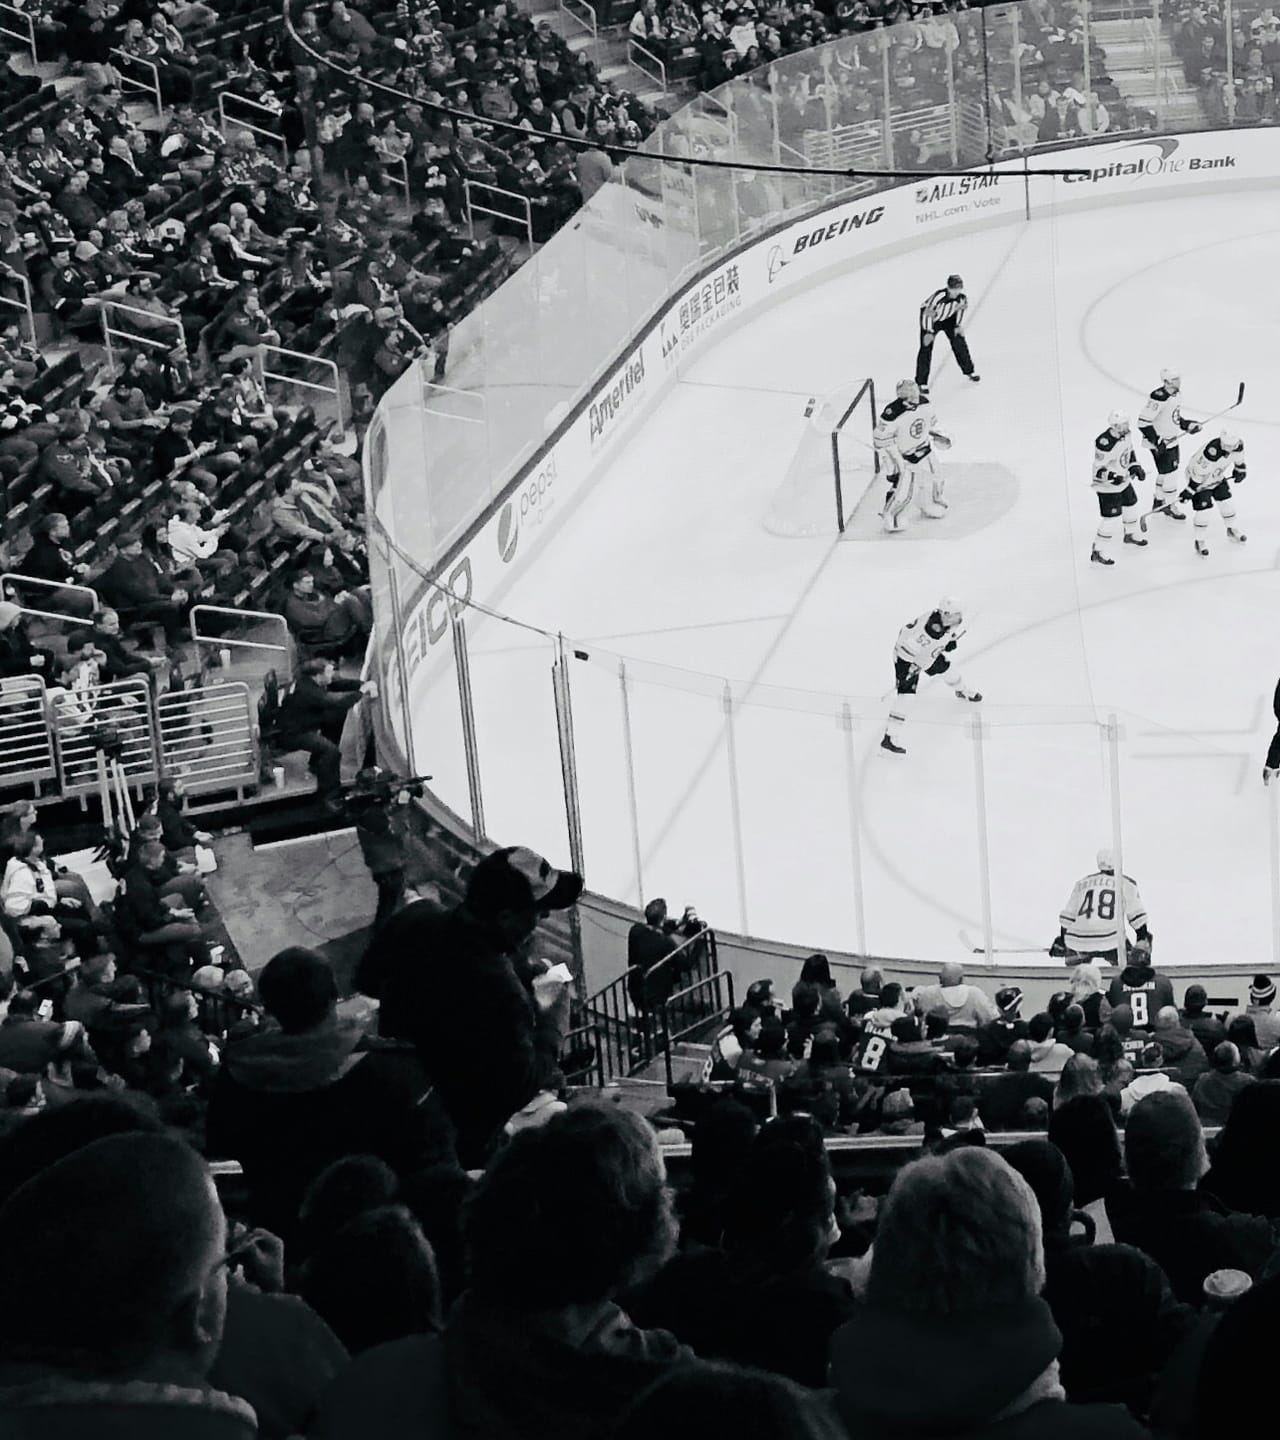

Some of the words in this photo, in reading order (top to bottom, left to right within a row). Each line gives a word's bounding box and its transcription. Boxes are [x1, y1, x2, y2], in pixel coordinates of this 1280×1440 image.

[1187, 155, 1237, 171] Bank
[791, 205, 886, 255] BOEING
[589, 347, 645, 445] Ameritel
[519, 452, 559, 526] pepsi
[1077, 888, 1115, 920] 48
[1130, 991, 1149, 1026] 8
[861, 1035, 887, 1071] 8
